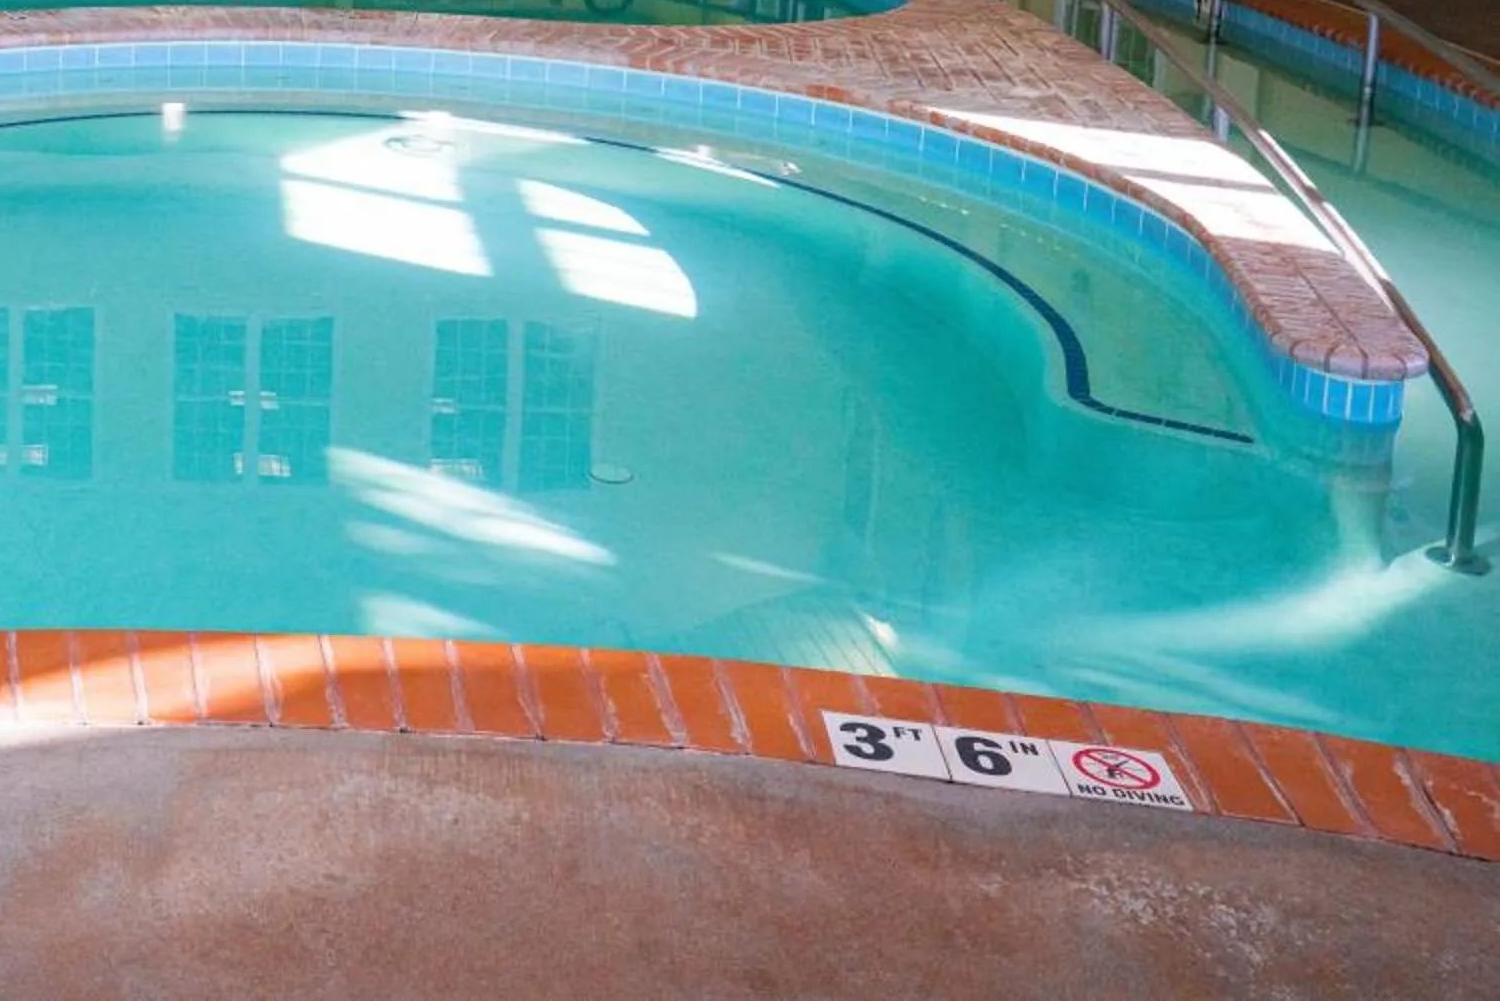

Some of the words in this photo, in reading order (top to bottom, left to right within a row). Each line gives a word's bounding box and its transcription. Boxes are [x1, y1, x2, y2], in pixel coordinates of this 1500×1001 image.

[839, 722, 894, 761] 3
[892, 726, 922, 741] FT
[955, 736, 1012, 776] 6
[1008, 740, 1039, 756] IN
[1077, 783, 1107, 796] NO
[1111, 788, 1185, 806] DIVING
